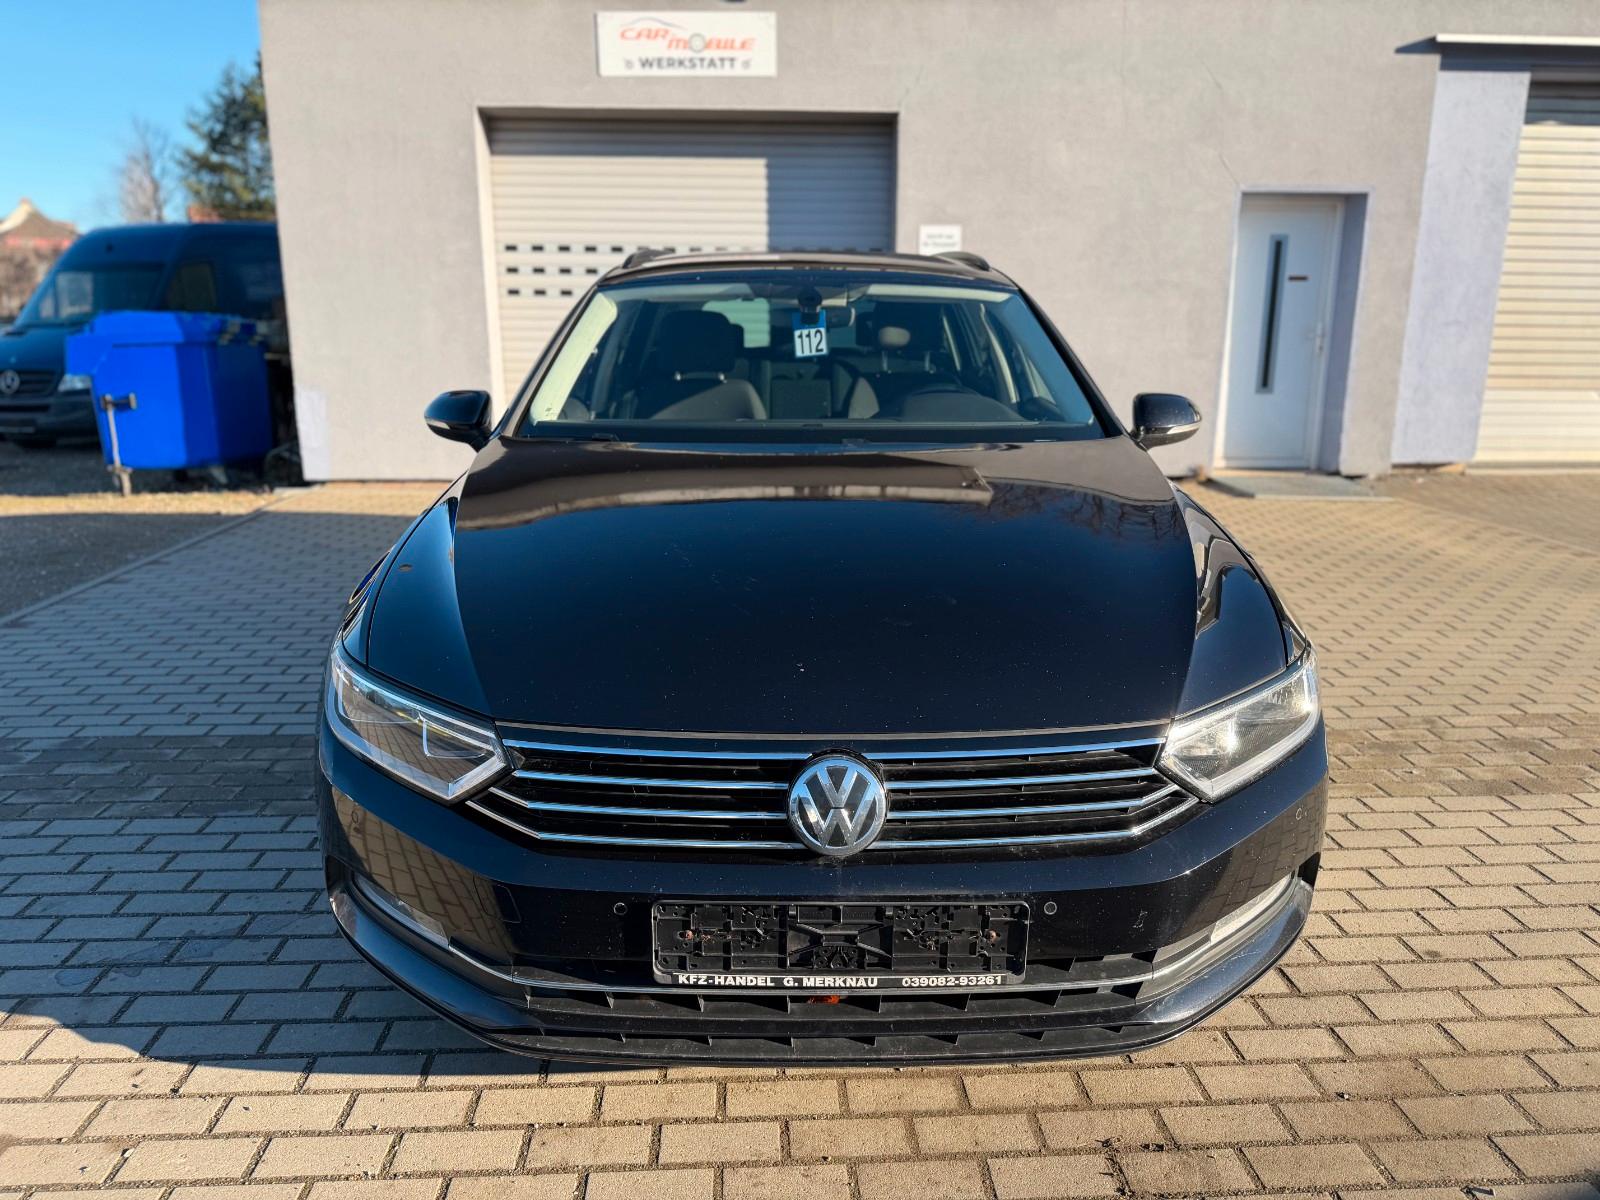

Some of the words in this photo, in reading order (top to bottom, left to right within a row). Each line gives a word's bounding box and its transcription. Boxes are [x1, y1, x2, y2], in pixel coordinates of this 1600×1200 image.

[620, 27, 669, 41] CAR
[638, 57, 736, 70] WERKSTATT
[797, 328, 824, 355] 112
[678, 974, 775, 987] KFZ-HANDEL
[783, 976, 798, 987] G.
[802, 976, 878, 987] MERKNAU
[902, 975, 1002, 987] 039082-93261
